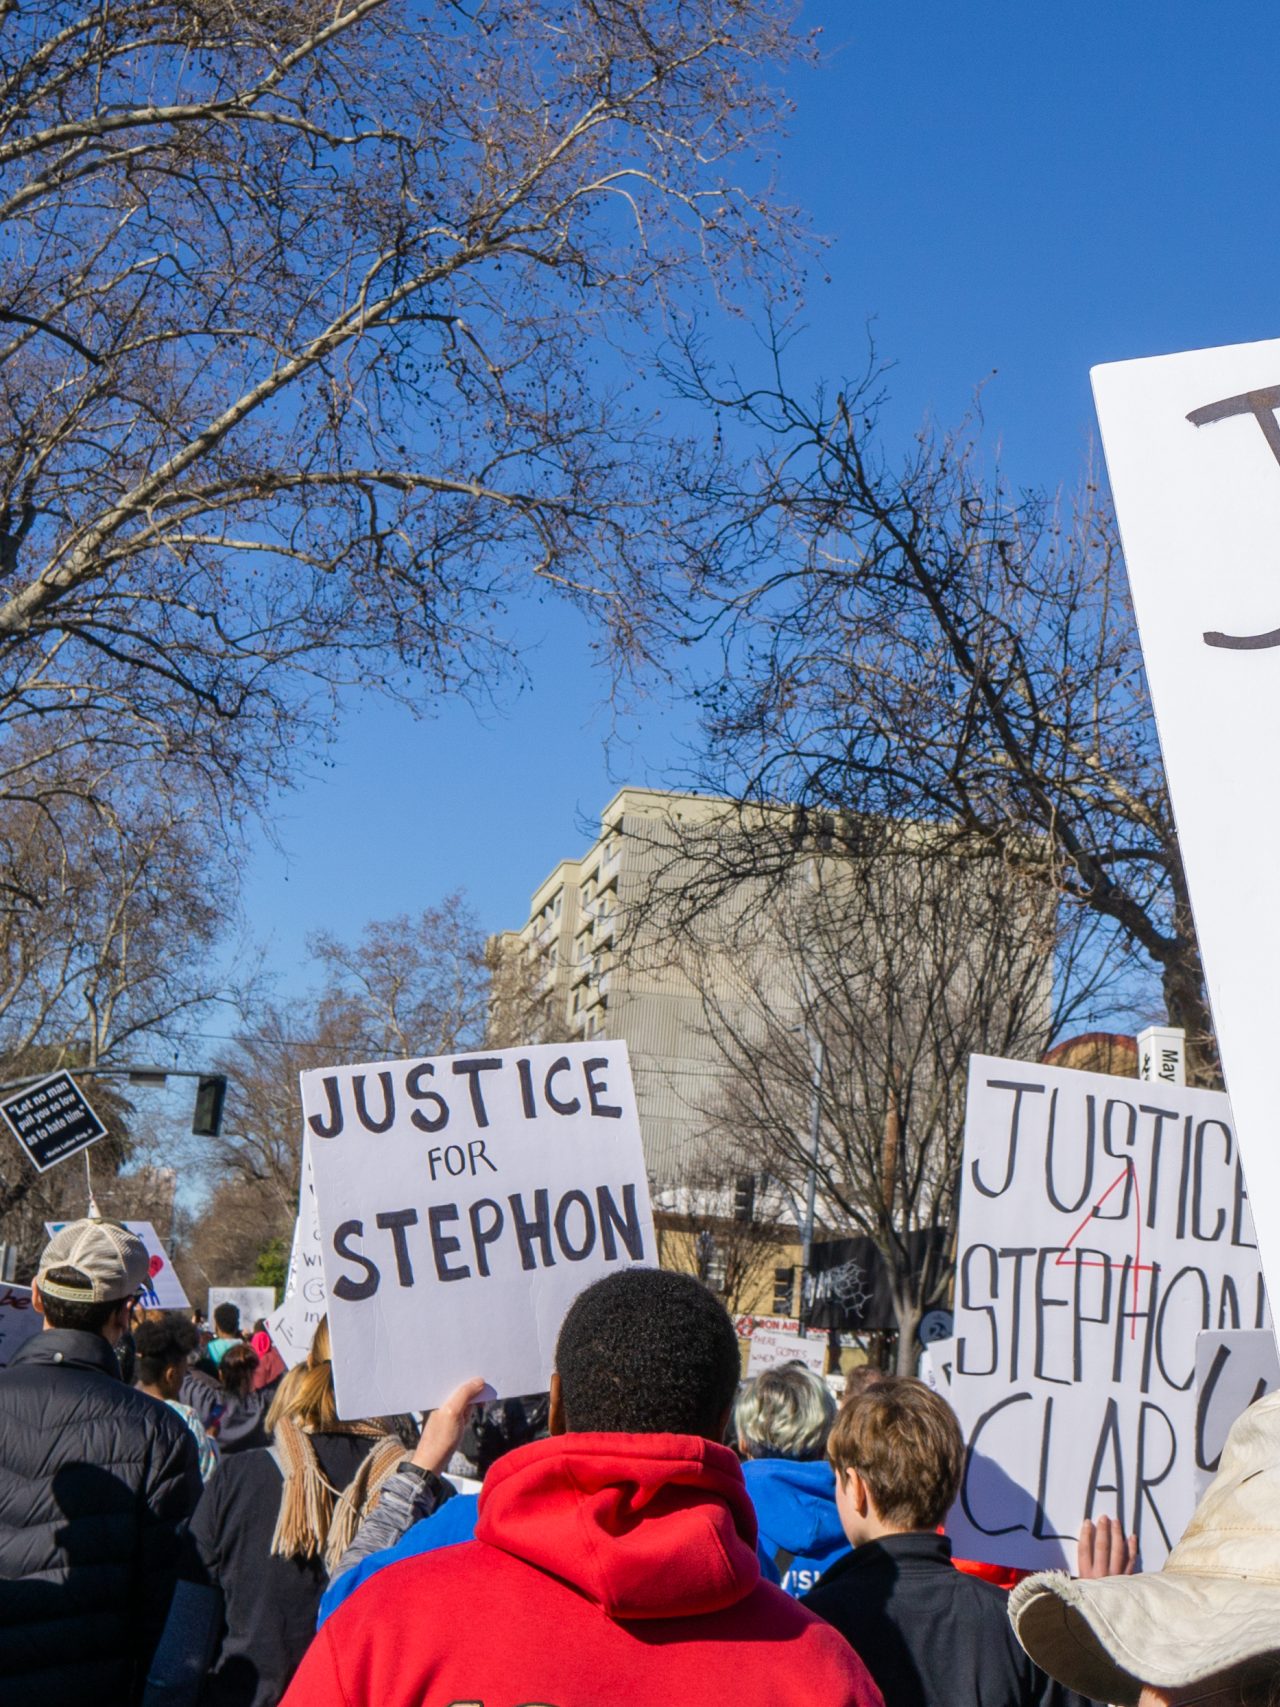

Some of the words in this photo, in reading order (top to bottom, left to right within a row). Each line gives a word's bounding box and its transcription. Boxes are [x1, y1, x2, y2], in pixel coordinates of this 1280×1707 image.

[32, 1093, 47, 1105] no
[46, 1081, 69, 1098] man
[307, 1057, 624, 1138] JUSTICE
[18, 1114, 36, 1132] pull
[33, 1107, 50, 1123] you
[50, 1102, 61, 1113] so
[36, 1129, 48, 1140] to
[428, 1140, 498, 1181] FOR
[332, 1183, 645, 1302] STEPHON
